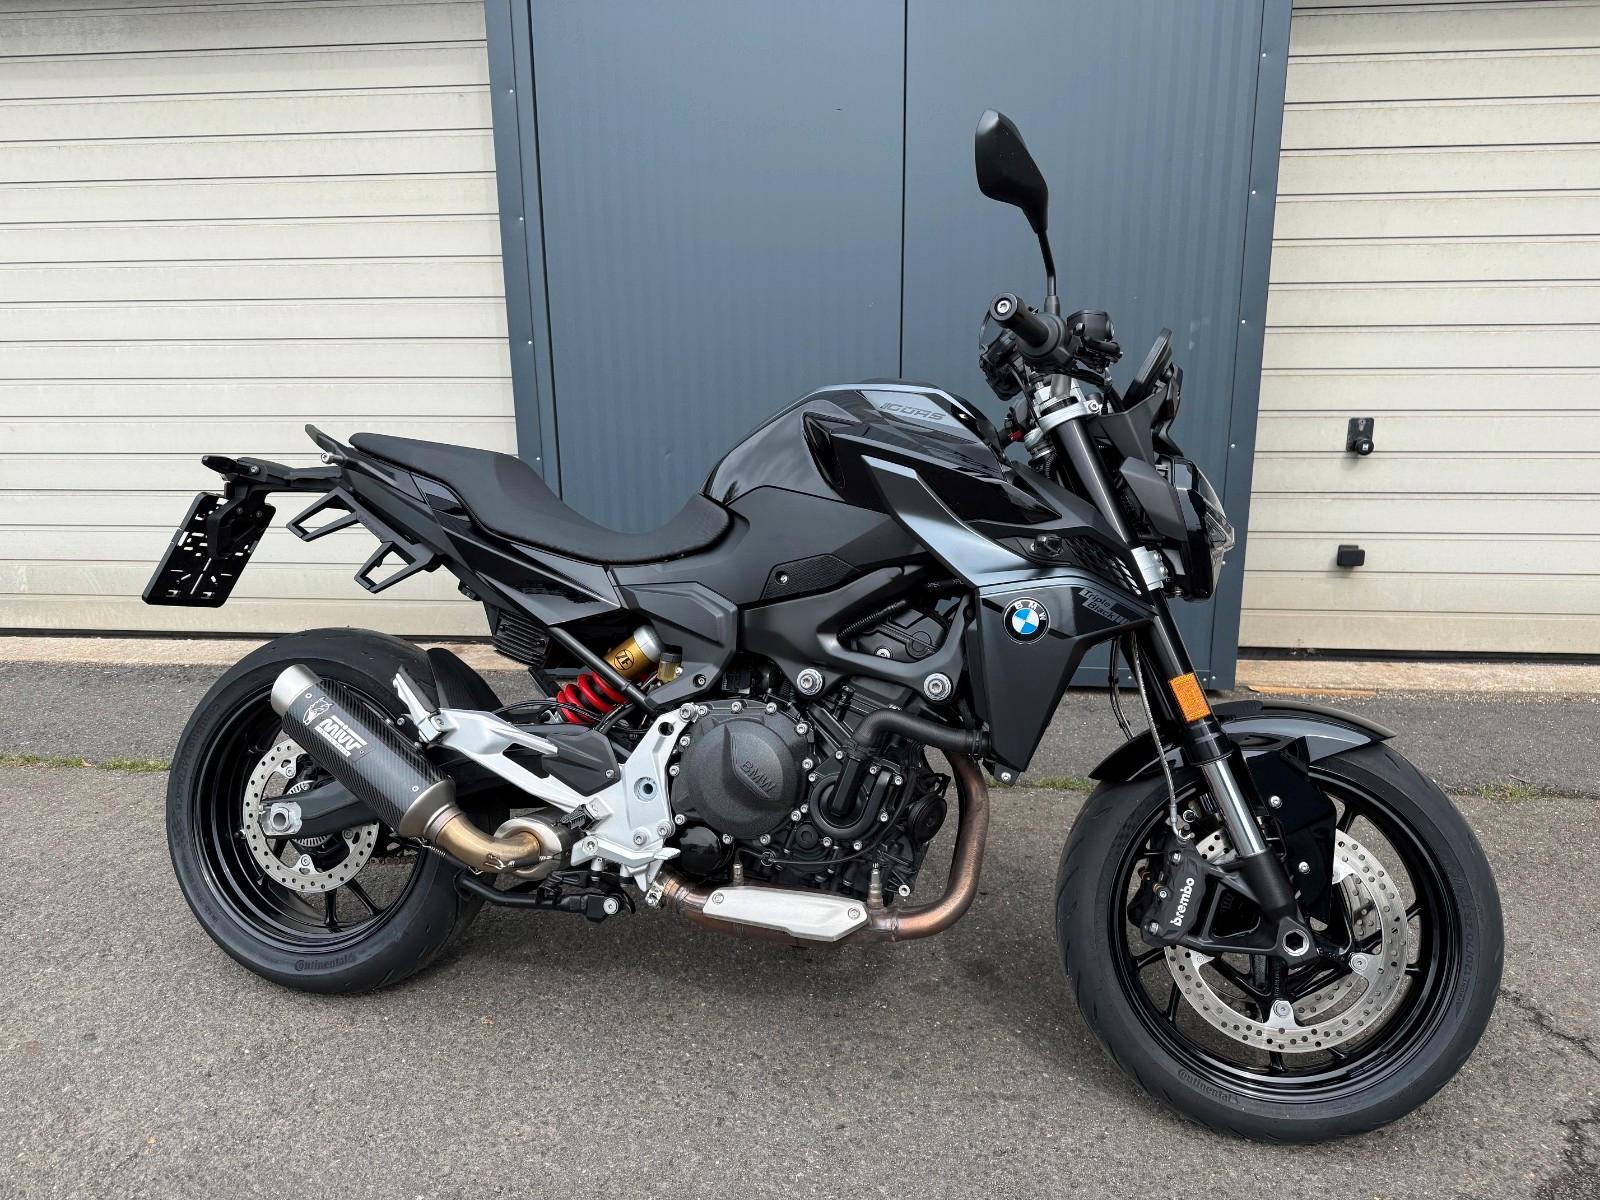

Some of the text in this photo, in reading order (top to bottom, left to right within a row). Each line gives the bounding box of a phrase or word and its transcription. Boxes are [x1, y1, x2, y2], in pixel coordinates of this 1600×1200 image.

[1083, 590, 1111, 608] Triple
[1014, 600, 1047, 621] BMW
[1087, 601, 1114, 619] Black
[615, 650, 634, 670] ZF
[740, 760, 777, 793] BMW
[1170, 877, 1195, 927] brembo
[294, 954, 348, 971] Continental
[1463, 935, 1475, 979] 120/70
[1177, 1069, 1232, 1103] Continental
